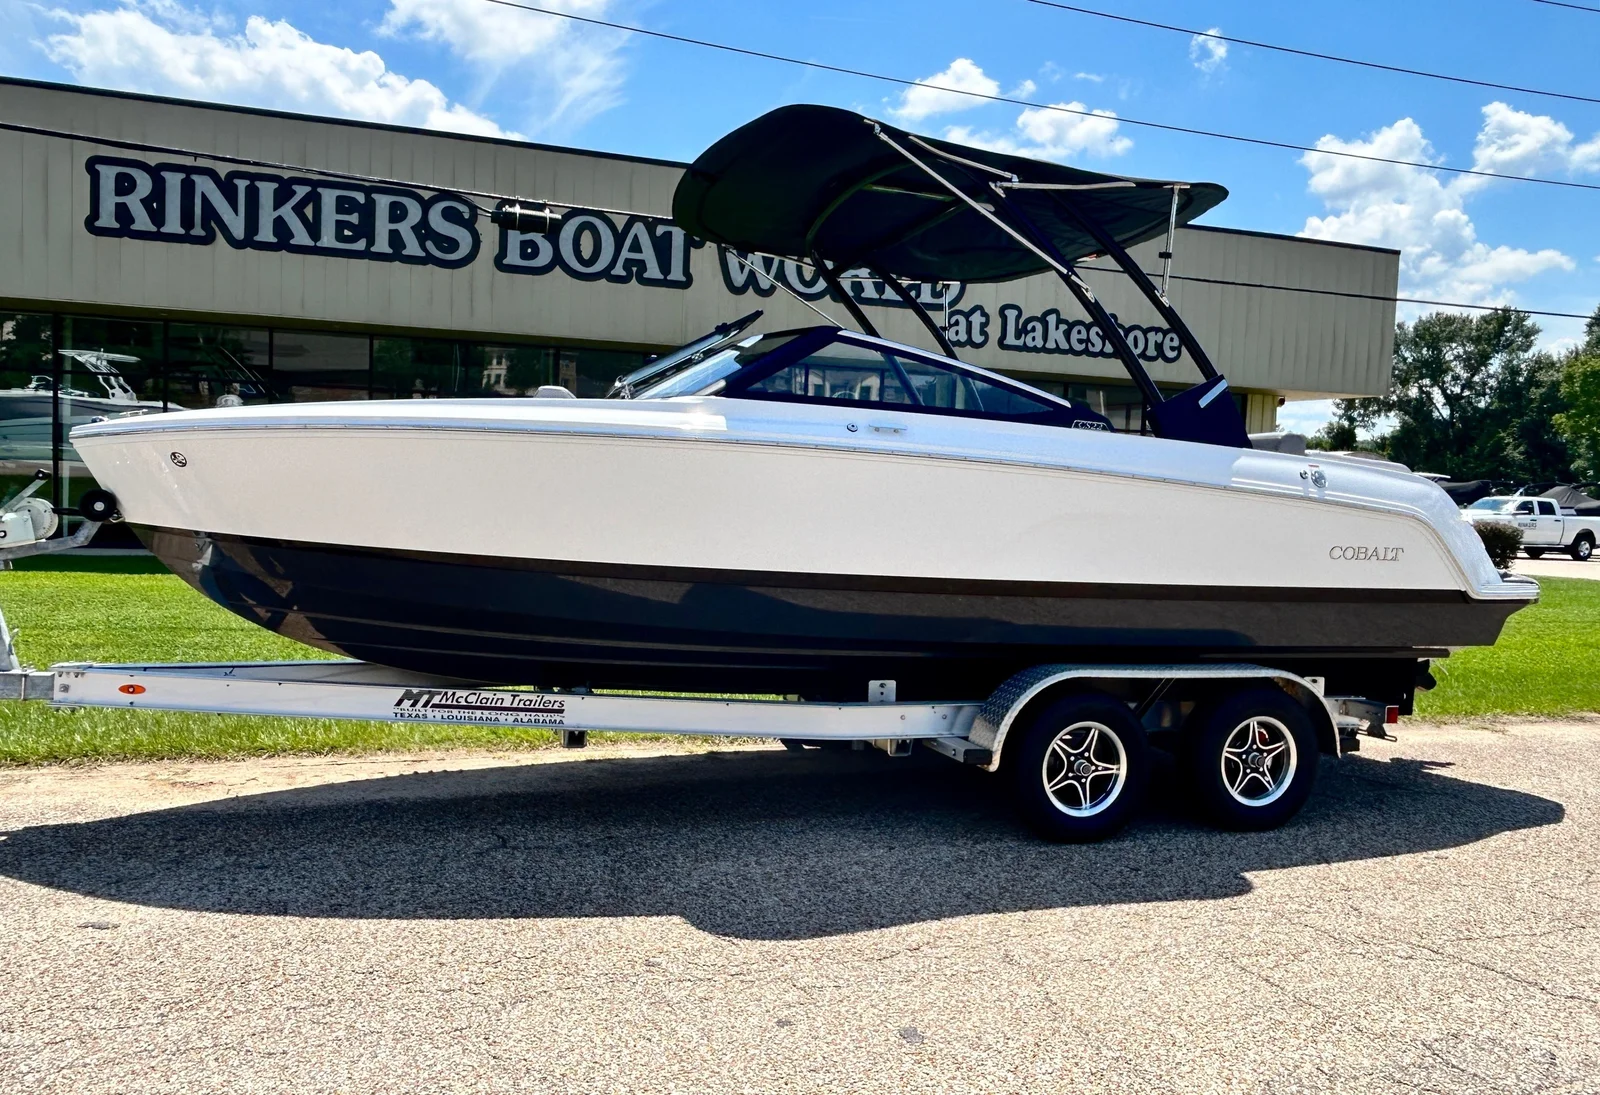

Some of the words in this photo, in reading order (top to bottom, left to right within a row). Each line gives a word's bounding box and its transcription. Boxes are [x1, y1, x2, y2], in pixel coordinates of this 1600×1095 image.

[91, 160, 476, 264] RINKERS
[500, 212, 691, 283] BOAT
[947, 309, 988, 345] at
[1002, 306, 1182, 360] Lakesore
[1328, 545, 1405, 561] COBALT
[439, 691, 505, 706] McClain
[510, 694, 565, 708] Trailers
[441, 714, 500, 722] LOUISIANA
[512, 717, 565, 725] ALABAMA
